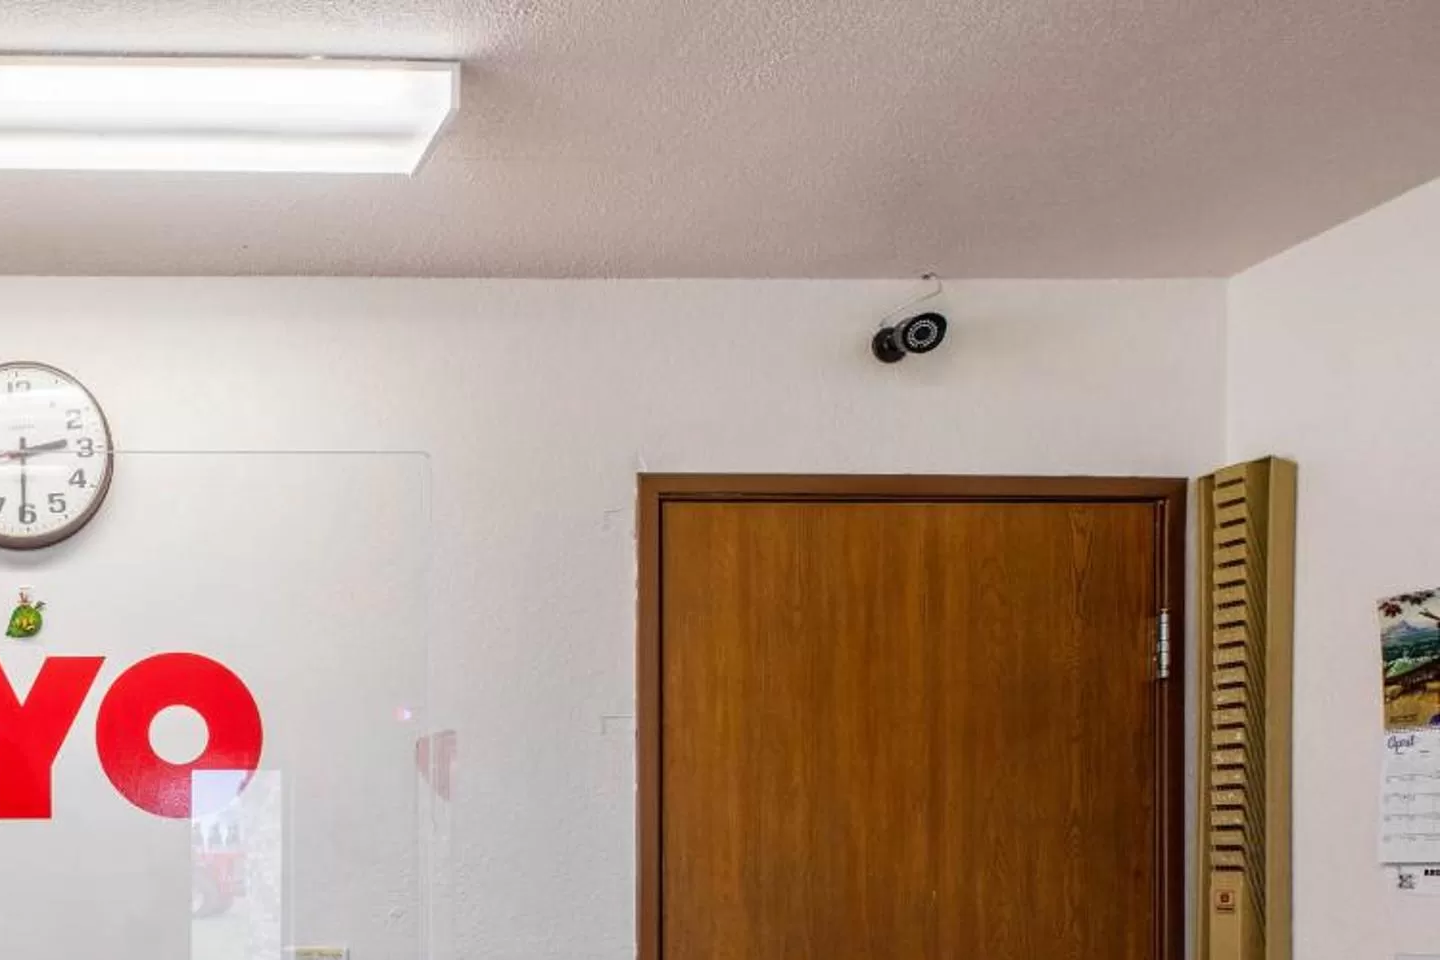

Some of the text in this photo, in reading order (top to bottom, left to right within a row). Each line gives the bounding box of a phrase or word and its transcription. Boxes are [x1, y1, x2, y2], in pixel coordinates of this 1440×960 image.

[66, 409, 82, 430] 2
[76, 438, 94, 458] 3
[68, 469, 87, 488] 4
[47, 493, 66, 513] 5
[18, 503, 37, 524] 6
